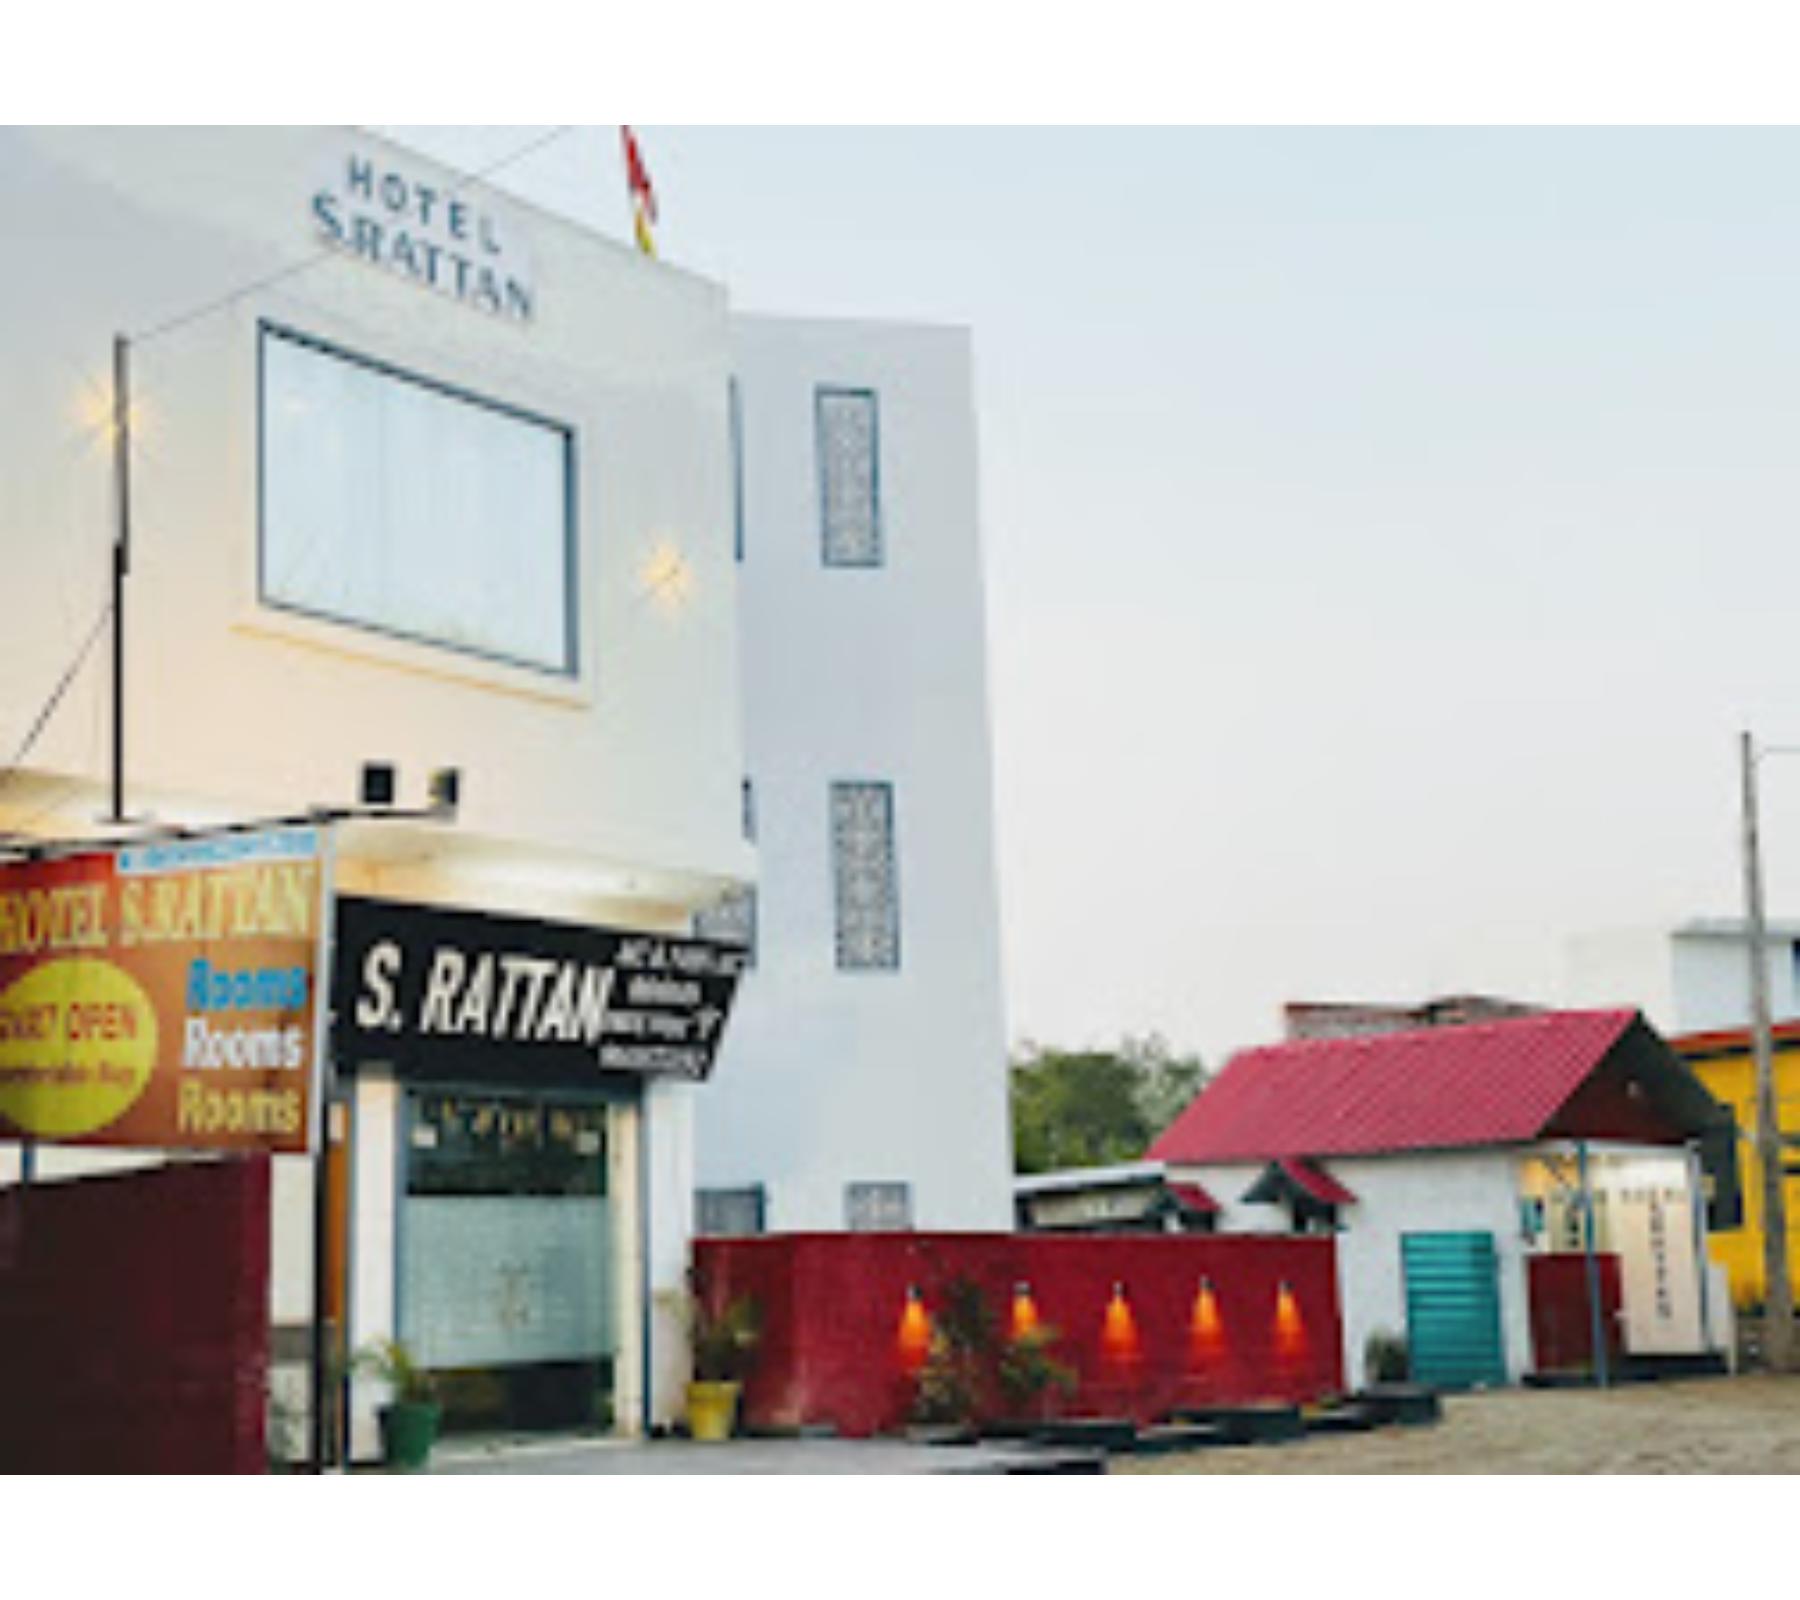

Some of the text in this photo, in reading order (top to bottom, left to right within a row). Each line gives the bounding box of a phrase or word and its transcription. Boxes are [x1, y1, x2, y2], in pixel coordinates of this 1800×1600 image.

[347, 152, 500, 254] HOTEL
[186, 957, 308, 1012] Rooms
[356, 940, 402, 1031] S.
[419, 946, 616, 1046] RATTAN
[65, 1002, 137, 1041] OPEN
[182, 1016, 304, 1069] Rooms
[177, 1077, 302, 1133] Rooms
